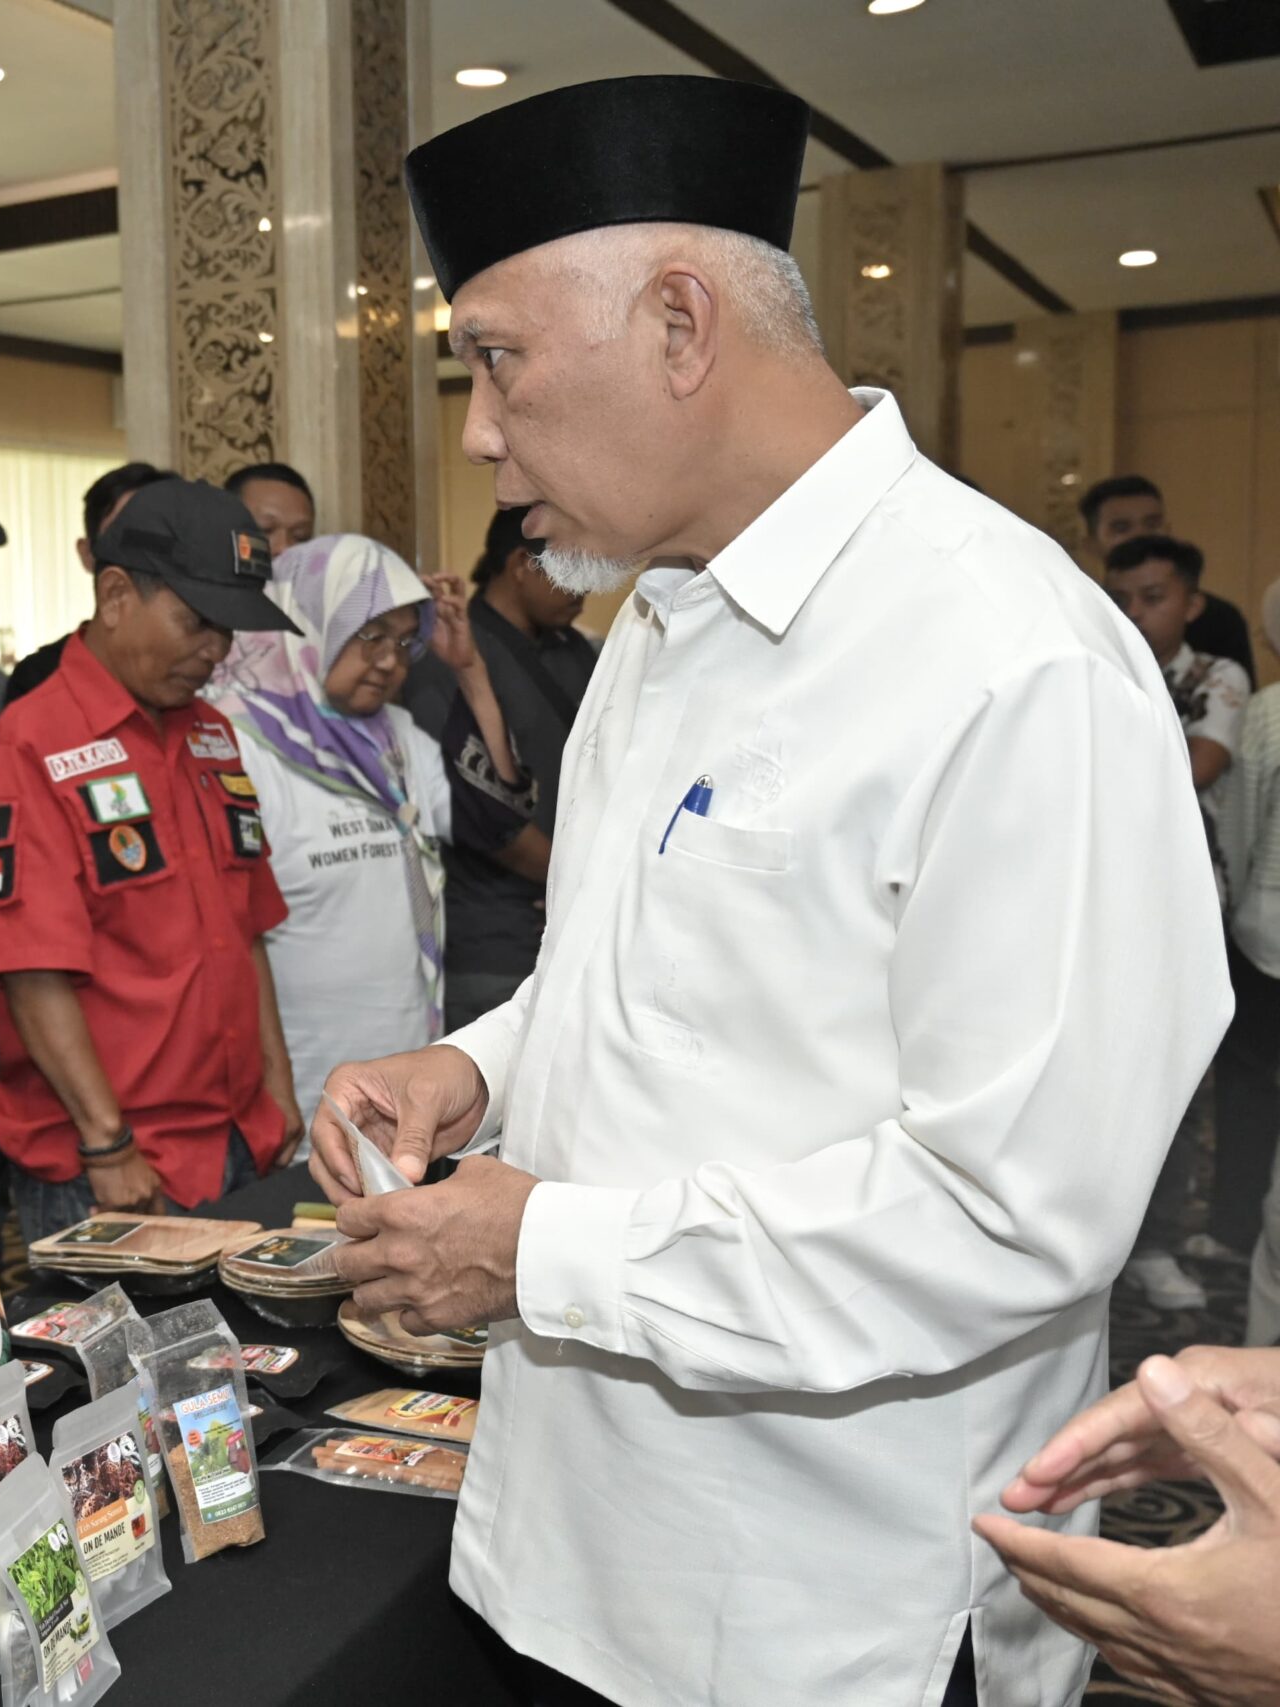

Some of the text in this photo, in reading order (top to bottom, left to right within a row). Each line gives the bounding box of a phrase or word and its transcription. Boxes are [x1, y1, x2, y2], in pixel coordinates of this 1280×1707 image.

[329, 819, 365, 838] WEST
[308, 842, 398, 868] WOMEN FOREST
[83, 1522, 126, 1554] ON DE MANDE
[43, 1642, 50, 1658] ON
[55, 1618, 71, 1644] MANDE
